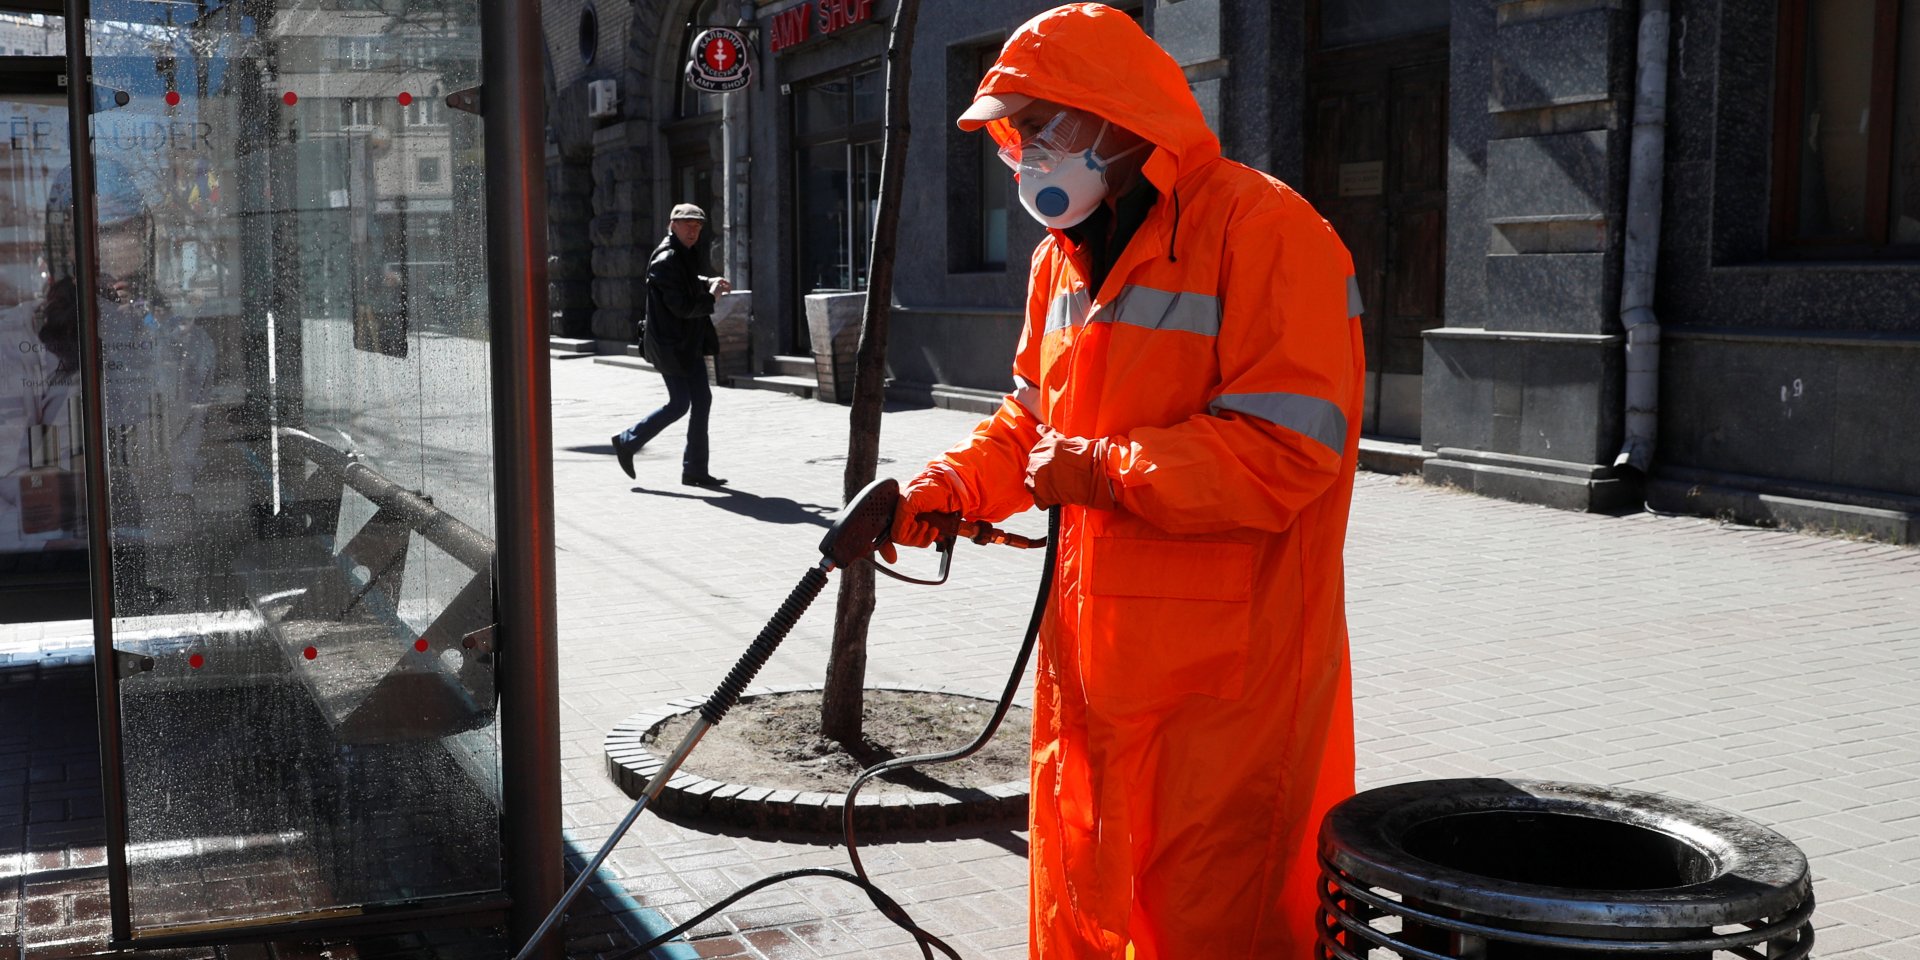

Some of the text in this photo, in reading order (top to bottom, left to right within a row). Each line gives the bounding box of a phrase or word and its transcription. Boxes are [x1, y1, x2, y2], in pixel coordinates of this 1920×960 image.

[700, 30, 742, 49] КАЛЬЯНИ
[768, 3, 811, 53] AMY
[696, 77, 746, 90] AMY SHOP
[66, 120, 214, 151] AUDER
